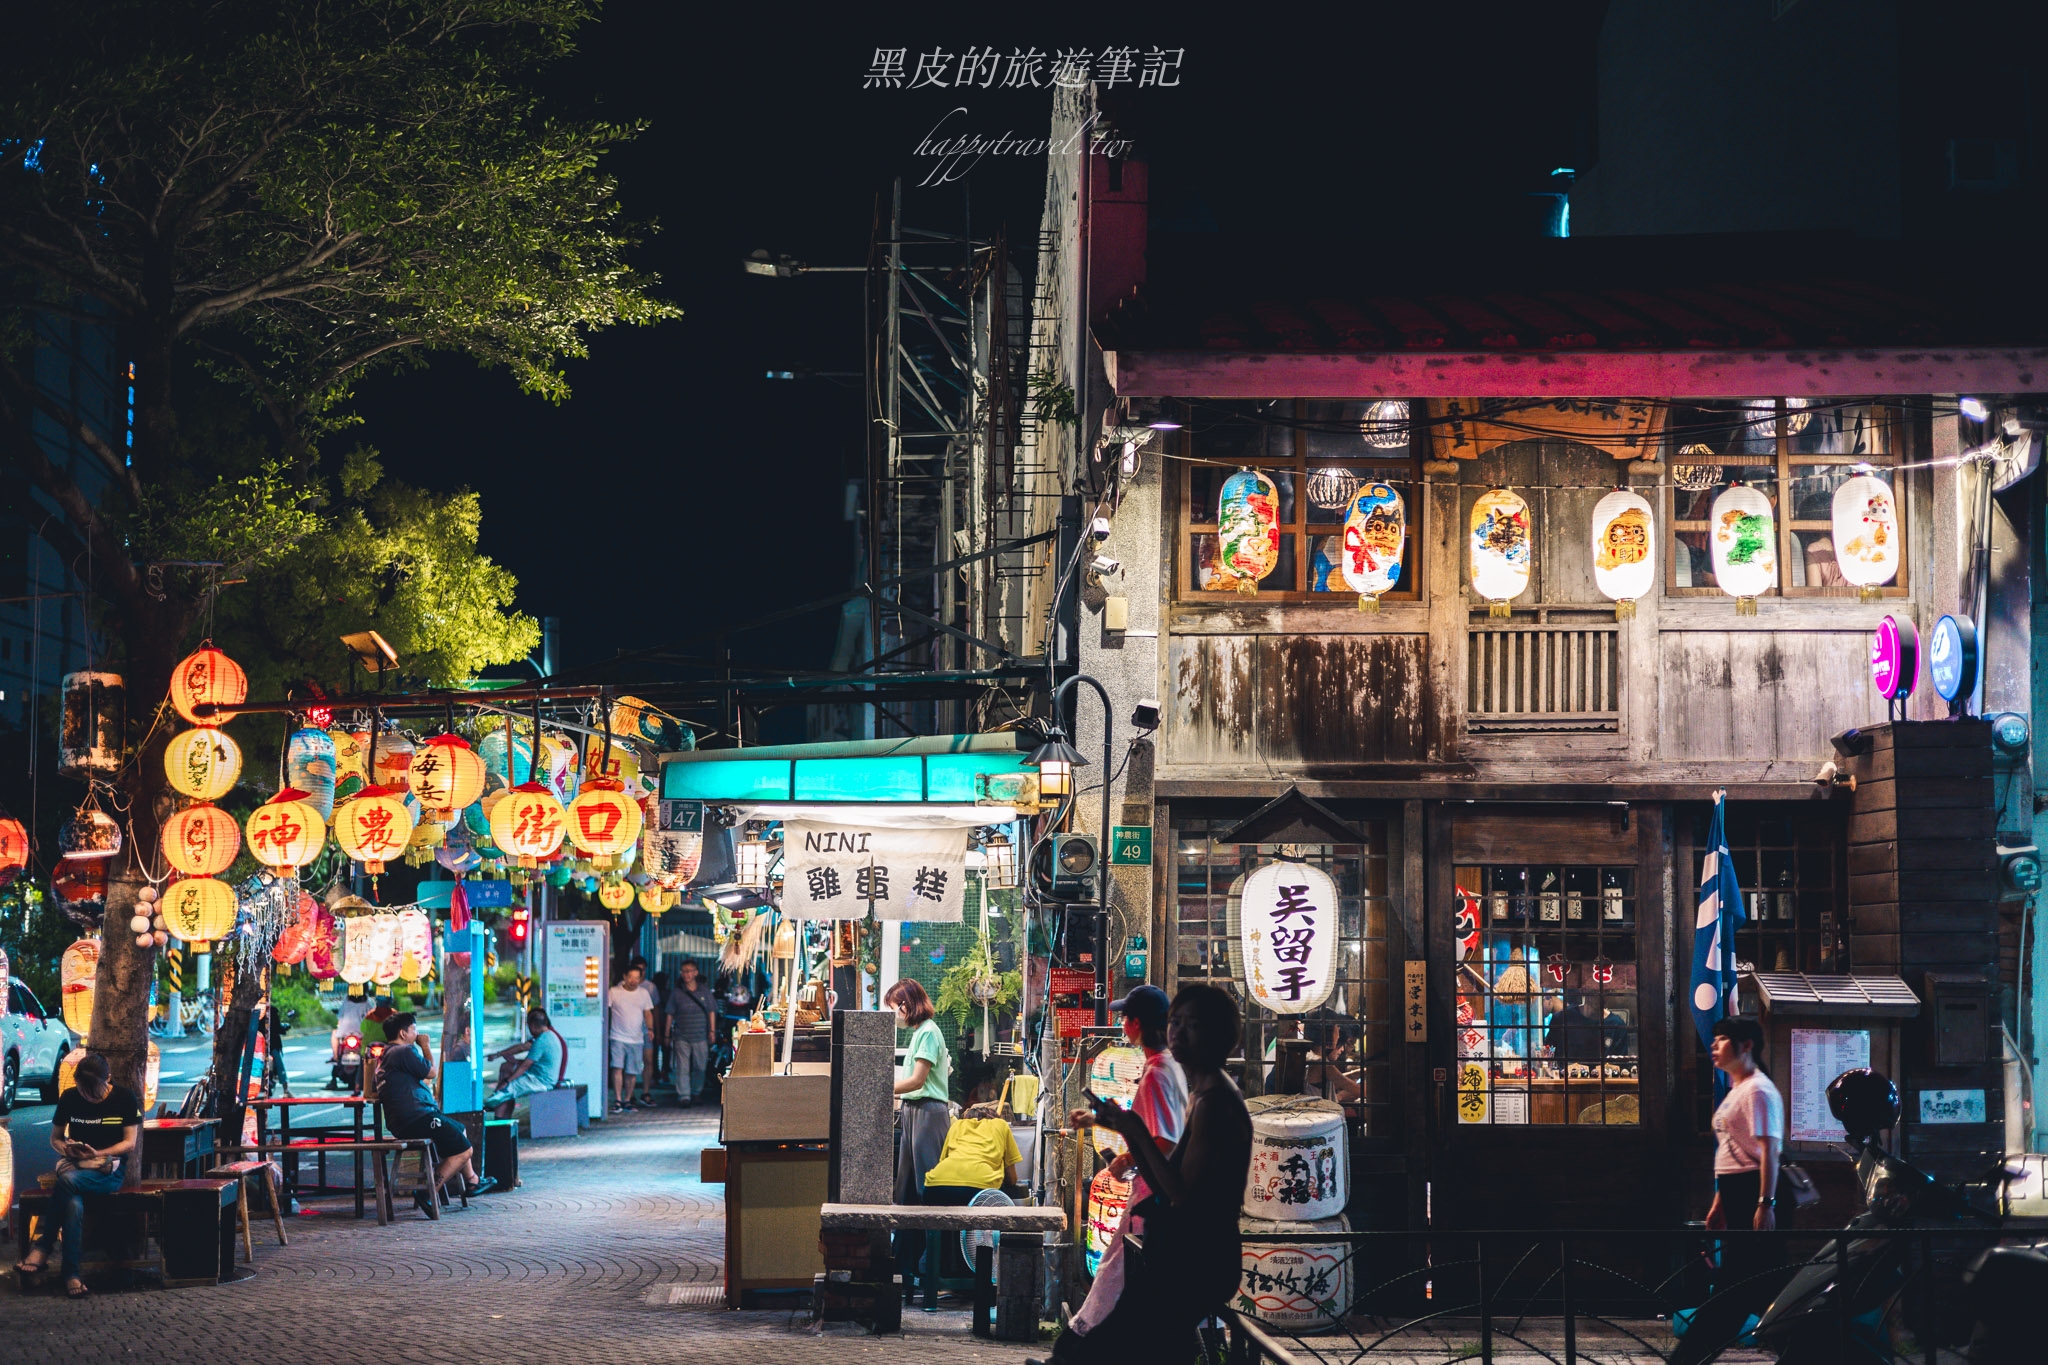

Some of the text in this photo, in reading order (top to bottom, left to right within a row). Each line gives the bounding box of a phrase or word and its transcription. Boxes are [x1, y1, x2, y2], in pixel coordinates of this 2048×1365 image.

[412, 753, 445, 803] 海安
[253, 813, 301, 859] 神
[357, 805, 401, 853] 農
[514, 804, 561, 848] 街
[577, 802, 622, 843] 口
[674, 811, 697, 827] 47
[805, 831, 872, 853] NINI
[1115, 830, 1141, 840] 神農街
[1122, 845, 1141, 859] 49
[806, 865, 948, 902] 雞蛋糕
[1246, 1264, 1330, 1295] 松竹梅
